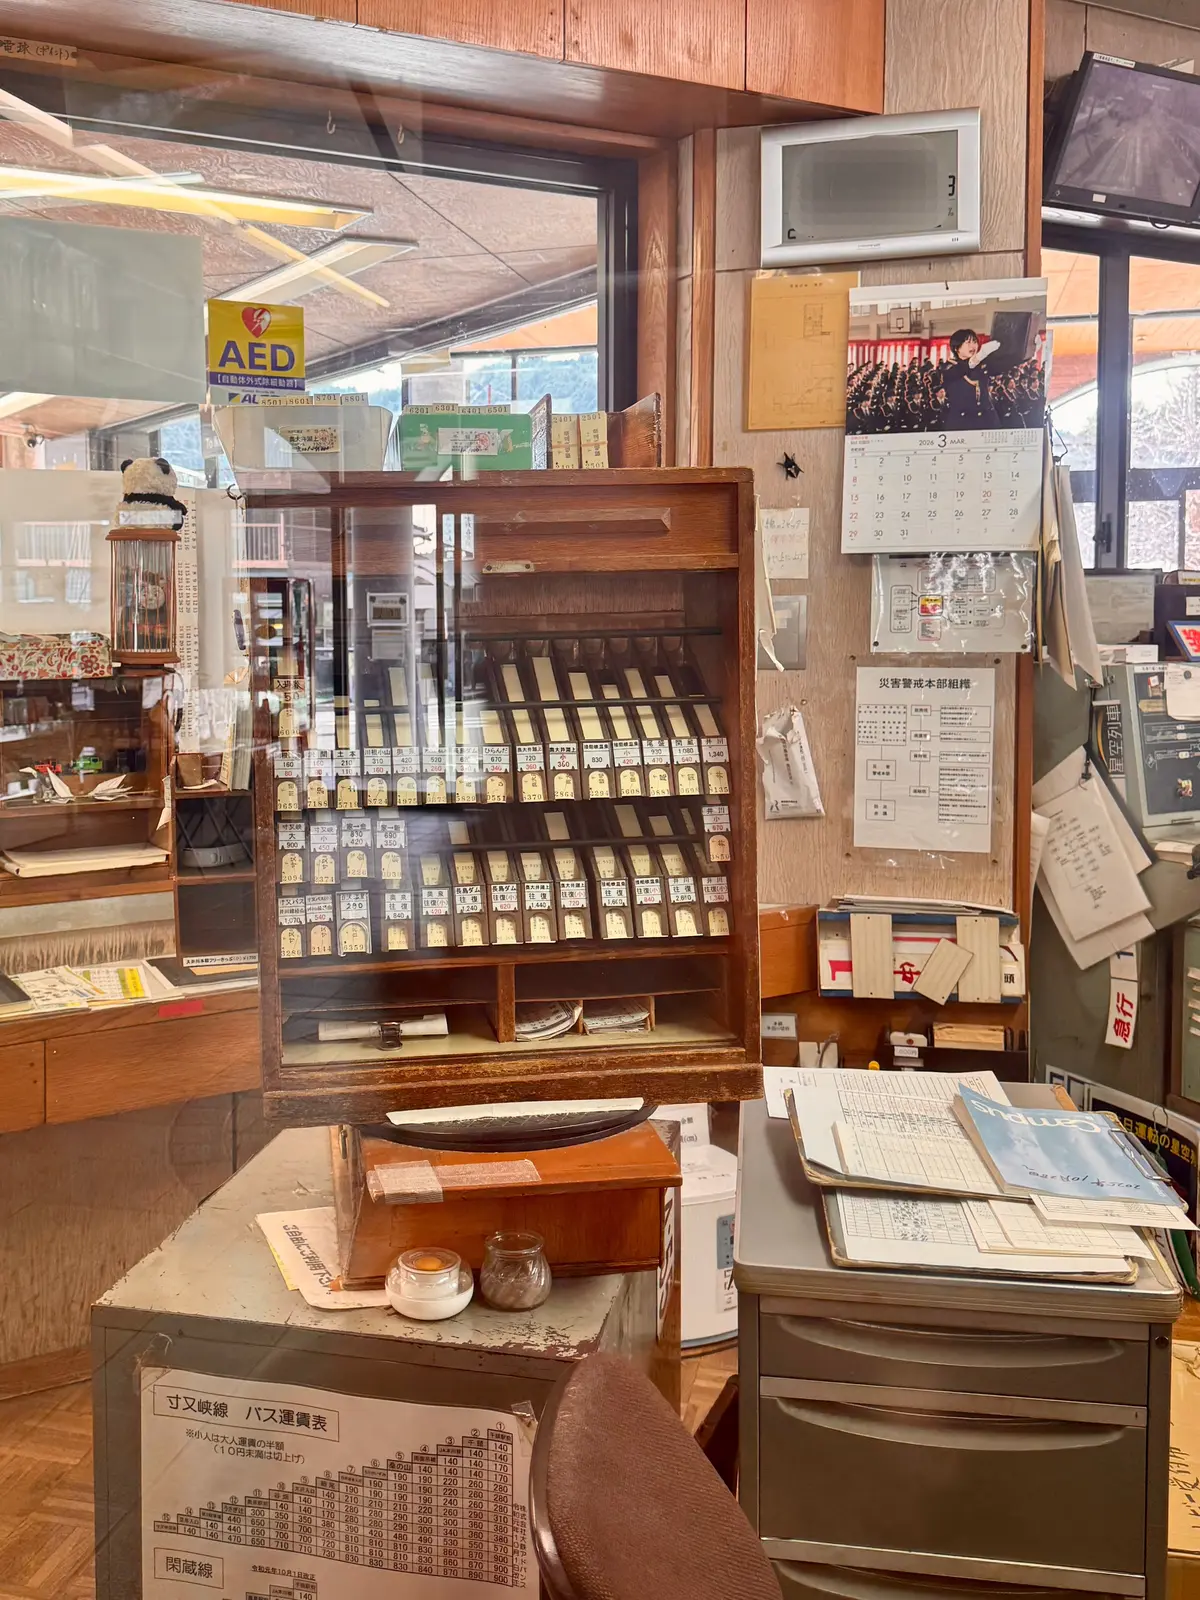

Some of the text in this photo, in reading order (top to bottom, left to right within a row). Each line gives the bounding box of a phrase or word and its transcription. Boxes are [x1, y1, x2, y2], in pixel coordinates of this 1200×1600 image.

[218, 341, 295, 371] AED
[938, 434, 947, 448] 3
[879, 678, 971, 690] 災害警戒本部組織
[1106, 705, 1123, 772] 星空列車
[1004, 974, 1015, 983] 頭
[1113, 992, 1134, 1042] 急行
[972, 1100, 1102, 1134] Campus
[167, 1394, 327, 1432] 寸又峡線 バス運賃表
[389, 1462, 411, 1471] 桑の山
[228, 1525, 241, 1533] 440
[275, 1532, 288, 1540] 700
[299, 1535, 312, 1543] 700
[322, 1540, 335, 1548] 720
[345, 1545, 359, 1553] 810
[369, 1550, 383, 1558] 810
[393, 1553, 408, 1561] 810
[418, 1555, 432, 1564] 830
[443, 1558, 458, 1567] 860
[469, 1560, 483, 1569] 870
[494, 1565, 508, 1574] 900
[228, 1535, 241, 1543] 470
[299, 1545, 312, 1553] 710
[345, 1554, 359, 1563] 830
[369, 1559, 383, 1568] 830
[393, 1562, 408, 1570] 830
[418, 1566, 432, 1574] 840
[443, 1569, 458, 1577] 870
[469, 1571, 483, 1579] 890
[494, 1575, 508, 1584] 900
[166, 1556, 213, 1578] 閑蔵線
